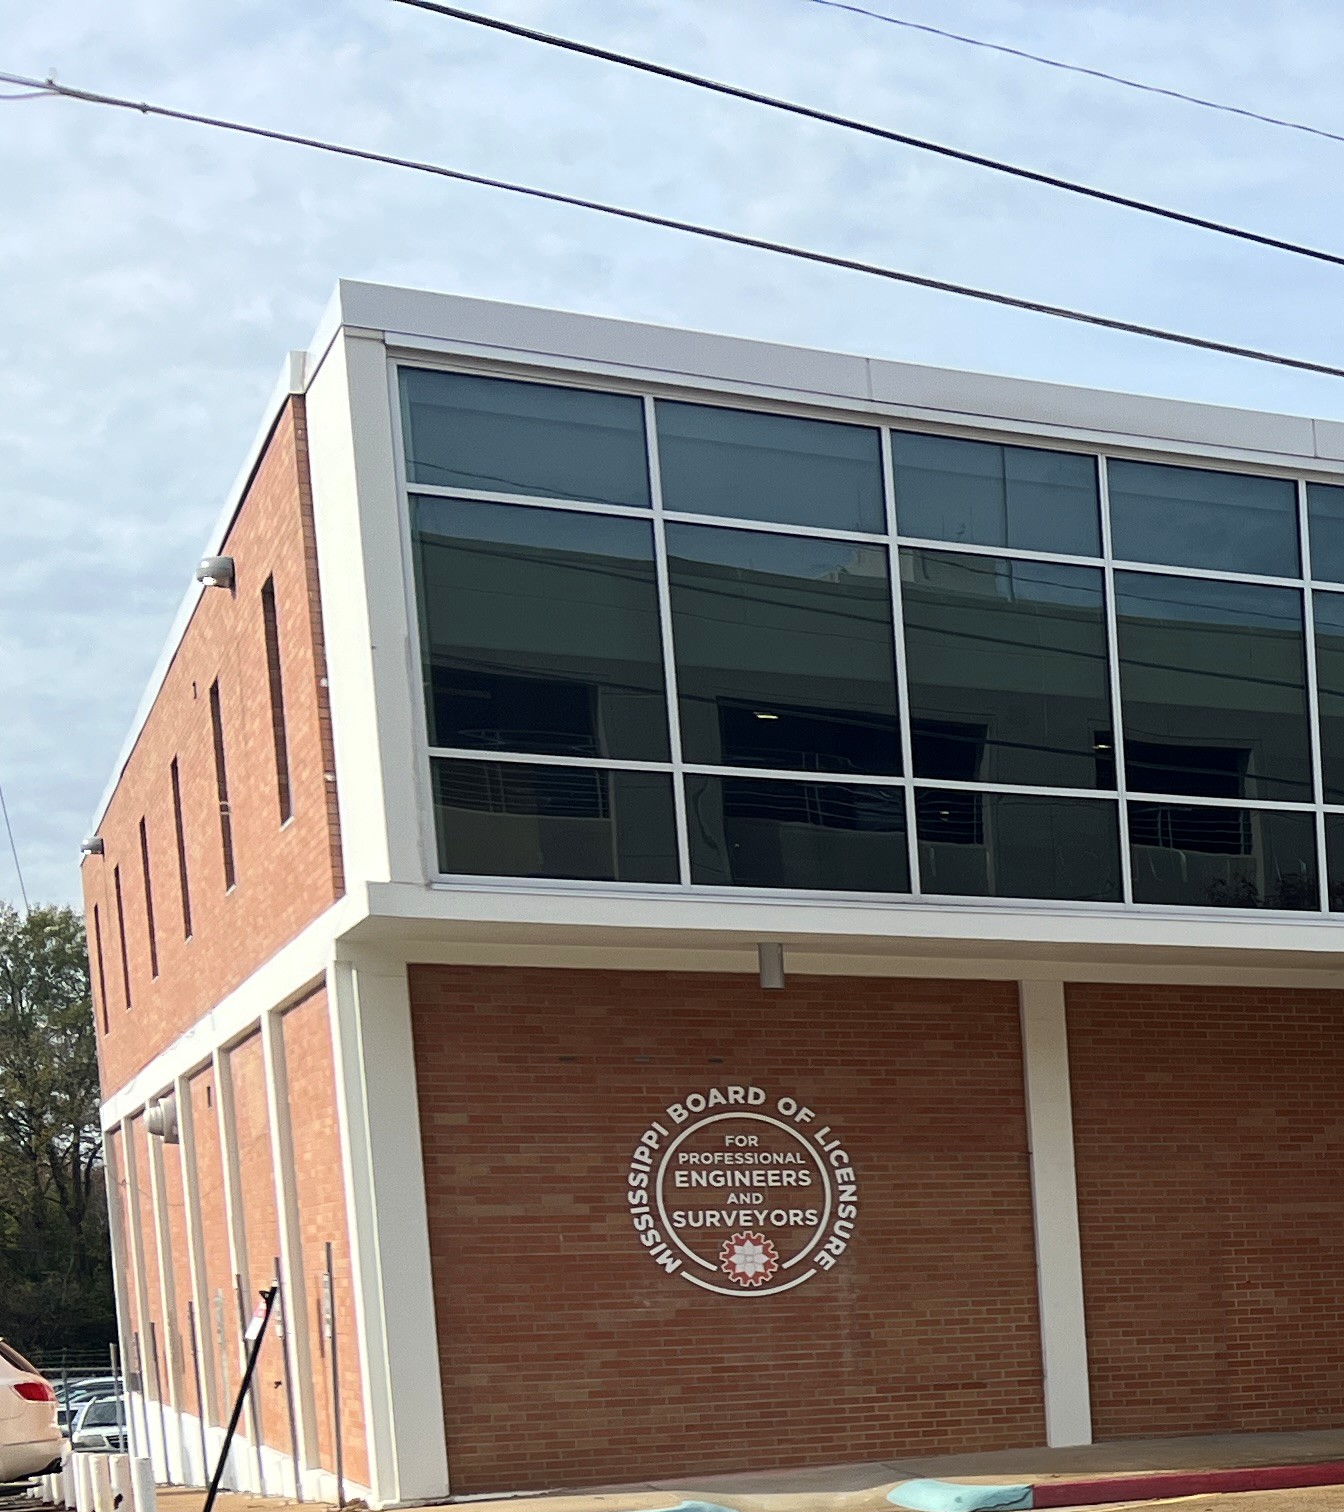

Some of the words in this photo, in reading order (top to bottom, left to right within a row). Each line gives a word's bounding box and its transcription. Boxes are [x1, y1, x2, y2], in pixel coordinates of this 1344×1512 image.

[725, 1135, 759, 1148] FOR
[678, 1152, 806, 1165] PROFESSIONAL
[627, 1121, 682, 1274] MISSISSIPPI
[666, 1086, 766, 1124] BOARD
[777, 1097, 816, 1124] OF
[814, 1126, 858, 1271] LICENSURE
[674, 1169, 812, 1188] ENGINEERS
[726, 1193, 763, 1205] AND
[672, 1209, 818, 1228] SURVEYORS
